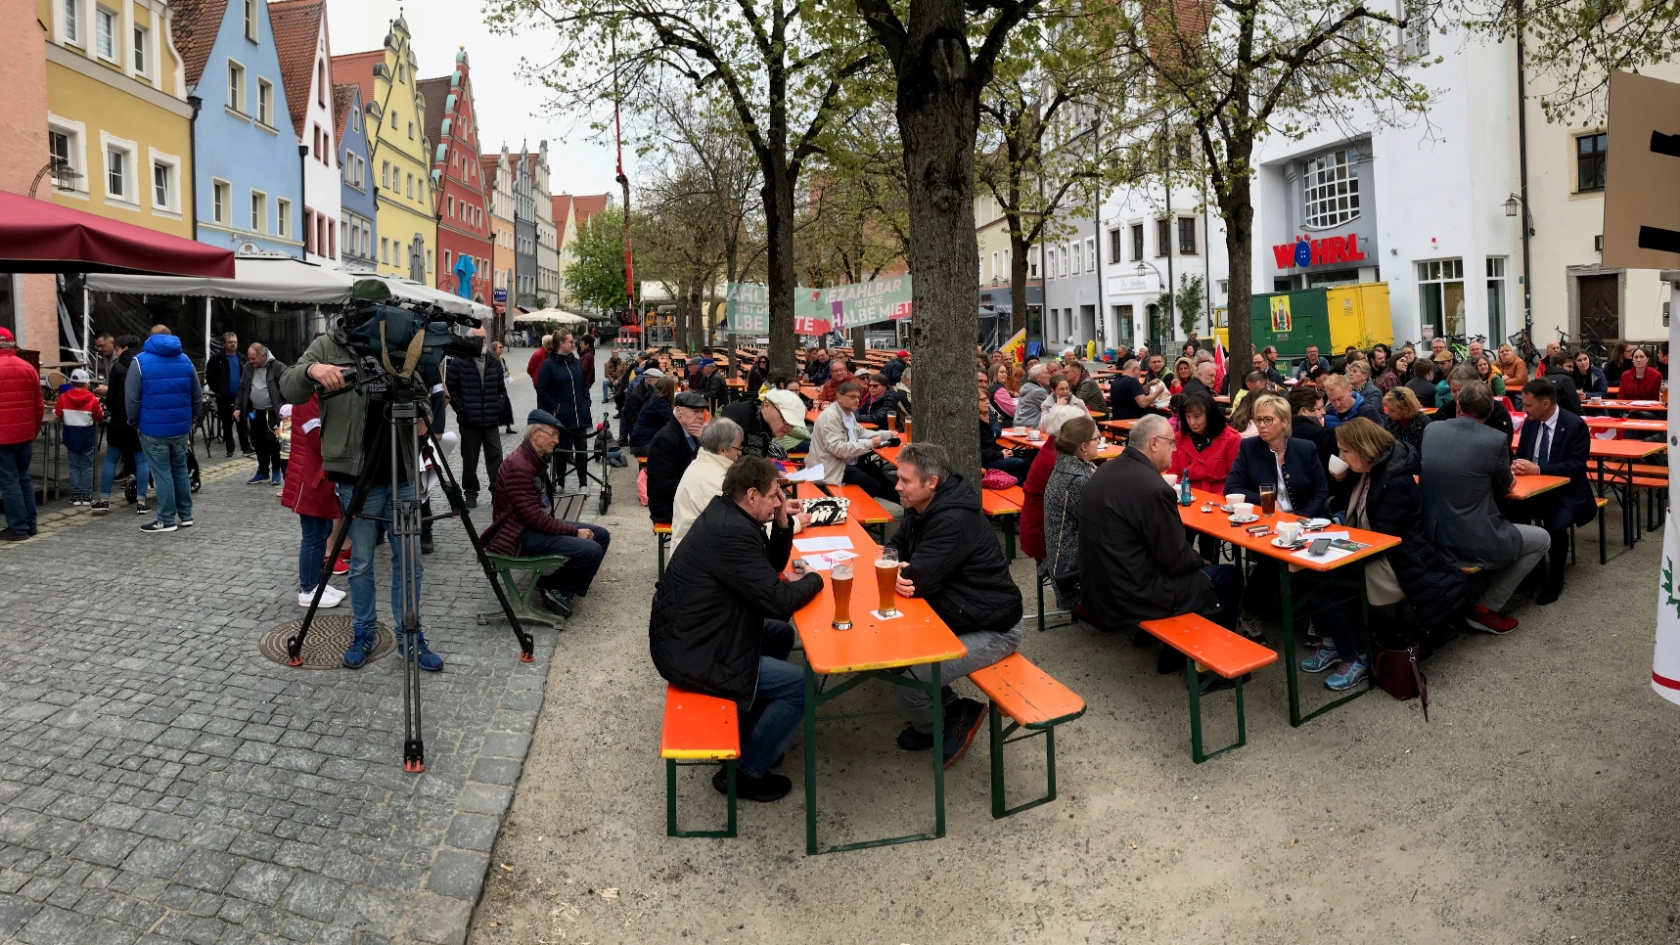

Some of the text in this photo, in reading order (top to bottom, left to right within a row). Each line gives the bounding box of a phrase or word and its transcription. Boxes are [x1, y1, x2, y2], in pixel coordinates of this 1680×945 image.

[1272, 233, 1366, 270] WÖHRL
[854, 295, 884, 308] IST DIE
[831, 306, 877, 328] HALBE
